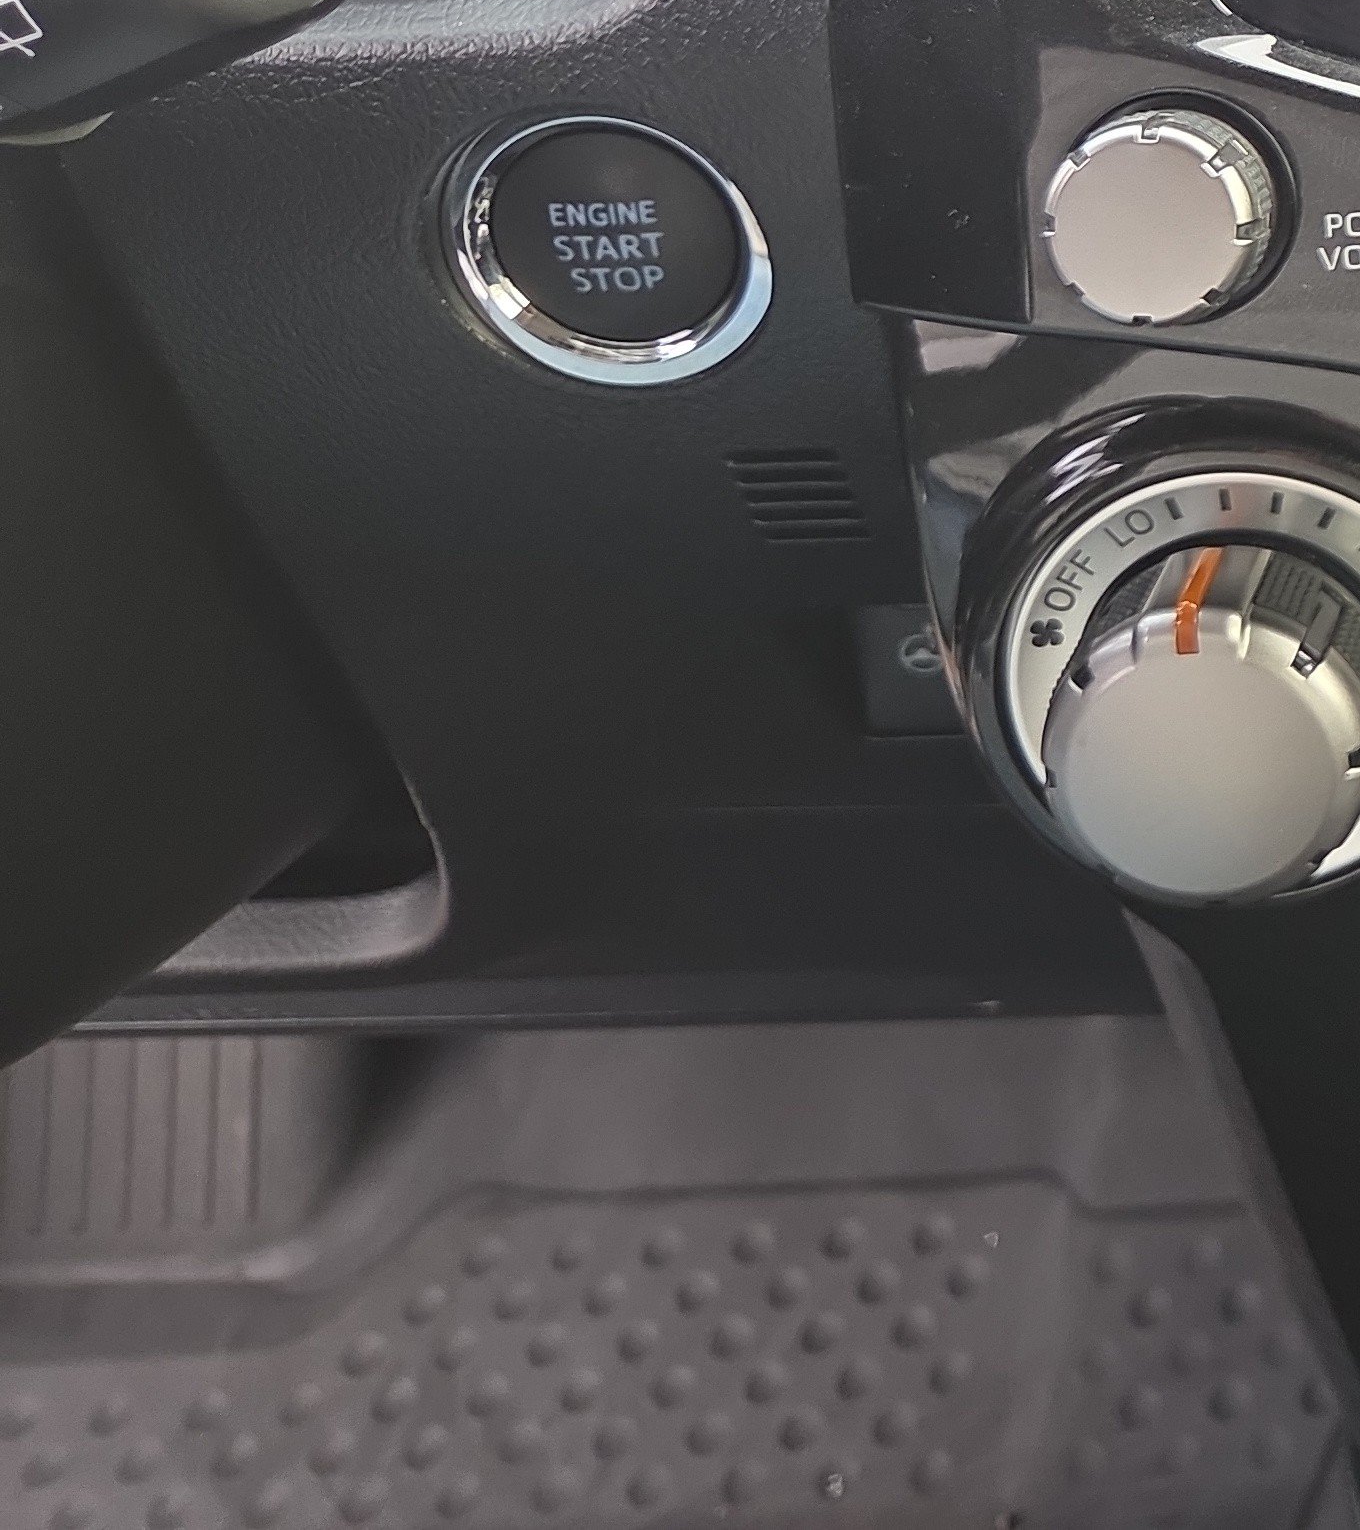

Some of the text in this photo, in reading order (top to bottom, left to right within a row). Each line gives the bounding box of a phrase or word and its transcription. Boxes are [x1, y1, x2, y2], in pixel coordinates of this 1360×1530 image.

[548, 200, 657, 227] ENGINE
[552, 231, 665, 262] START
[570, 266, 665, 294] STOP
[1102, 507, 1157, 549] LO
[1042, 548, 1096, 616] OFF
